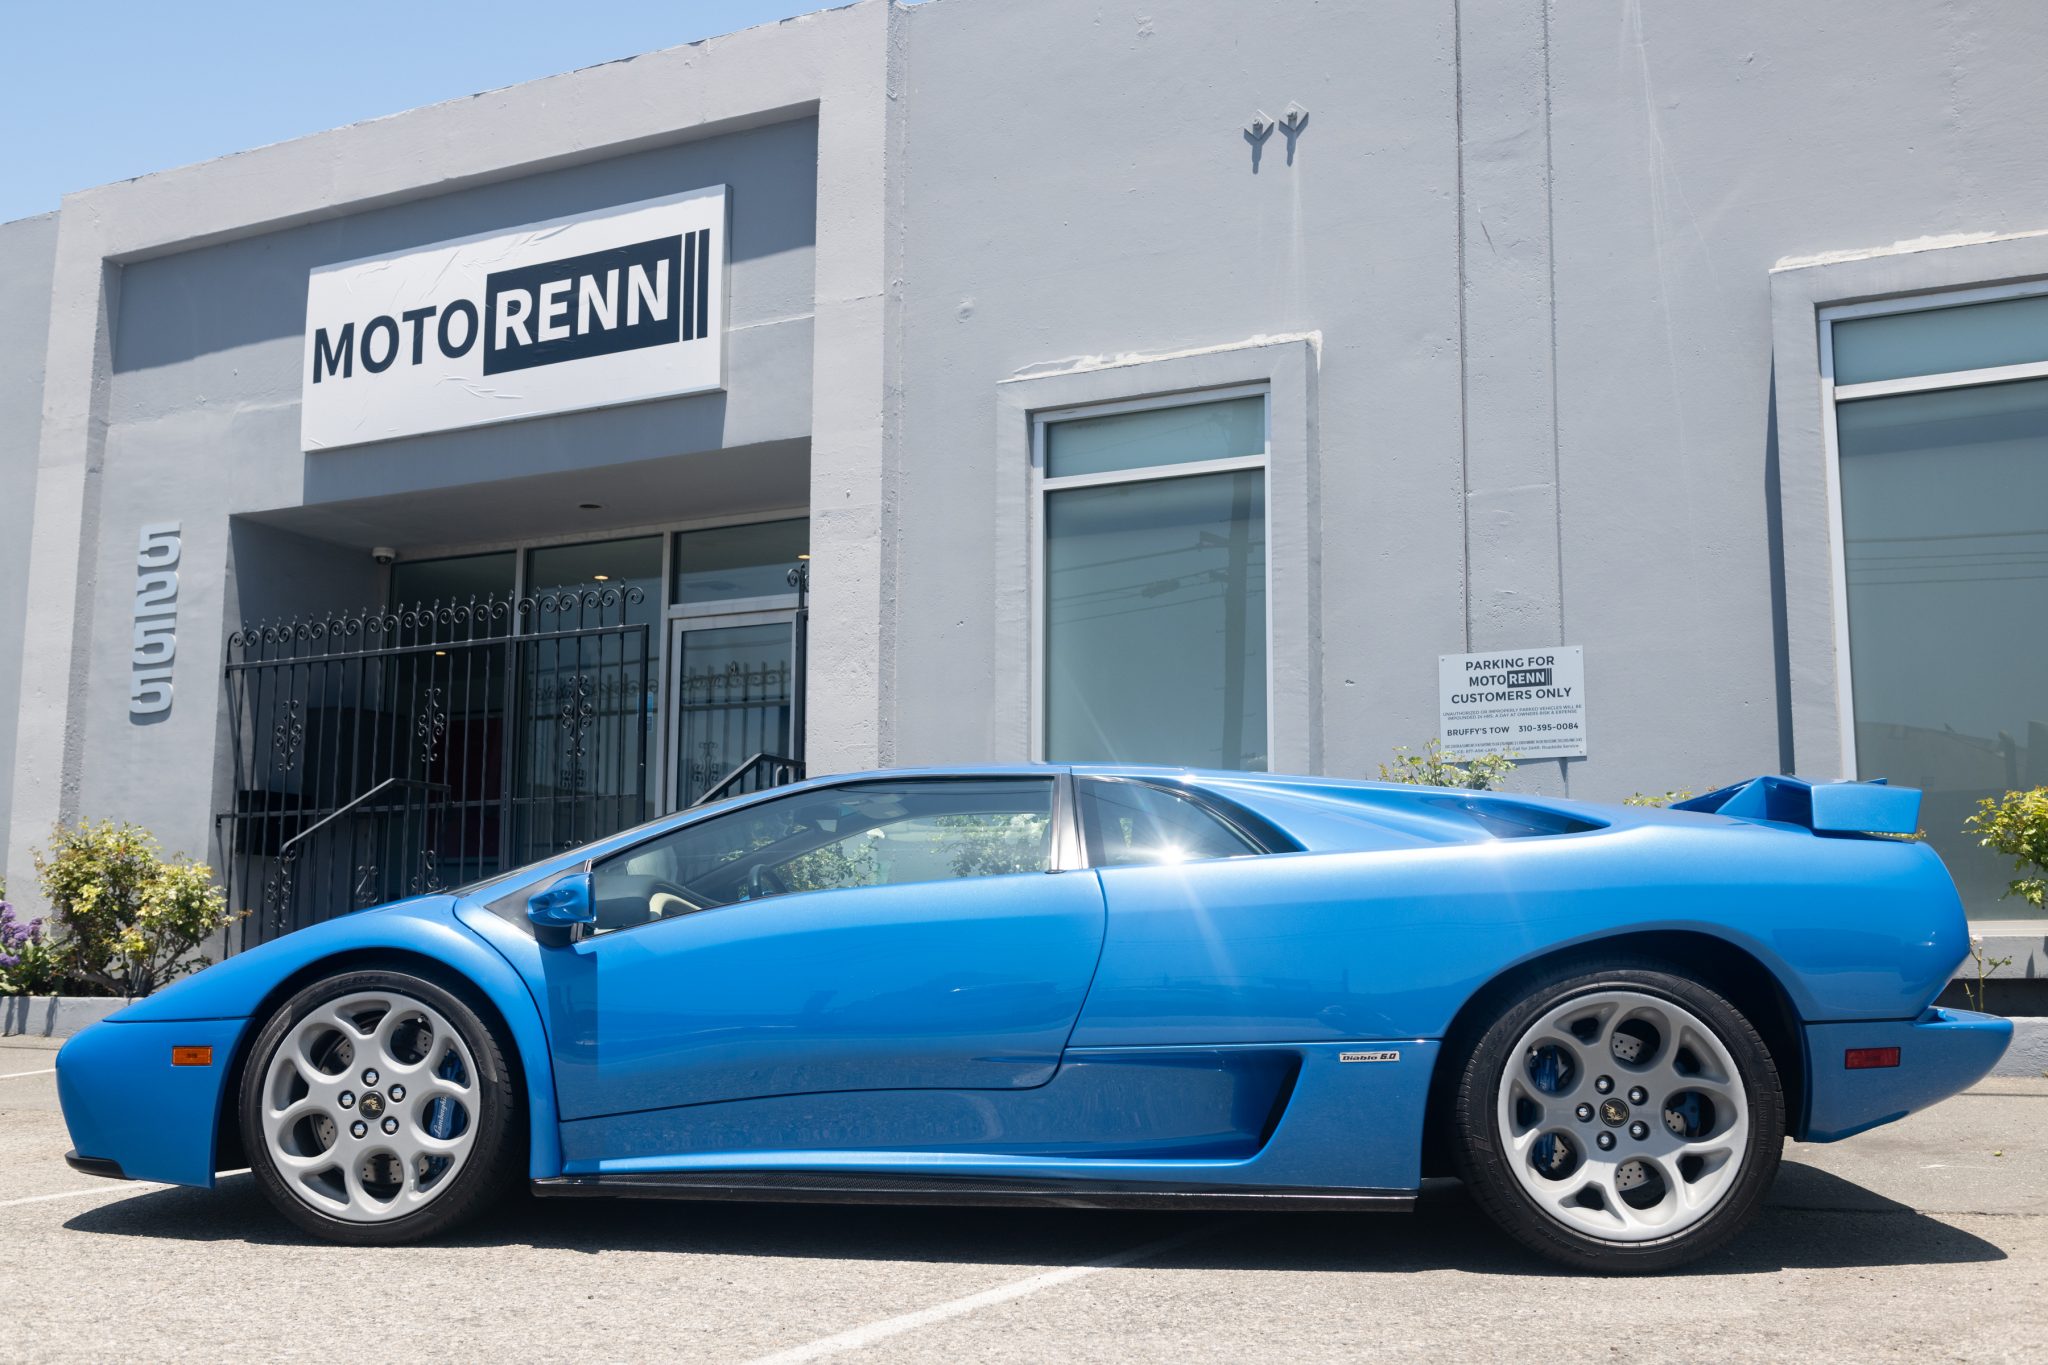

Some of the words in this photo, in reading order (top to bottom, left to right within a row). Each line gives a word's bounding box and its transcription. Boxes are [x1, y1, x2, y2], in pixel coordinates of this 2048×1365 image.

[129, 521, 182, 714] 5255
[1465, 658, 1524, 671] PARKING
[1528, 655, 1555, 667] FOR
[1451, 689, 1532, 704] CUSTOMERS
[1535, 687, 1572, 699] ONLY
[1447, 728, 1487, 736] BRUFFY'S
[1490, 726, 1510, 734] TOW
[1518, 722, 1579, 733] 310-395-0084
